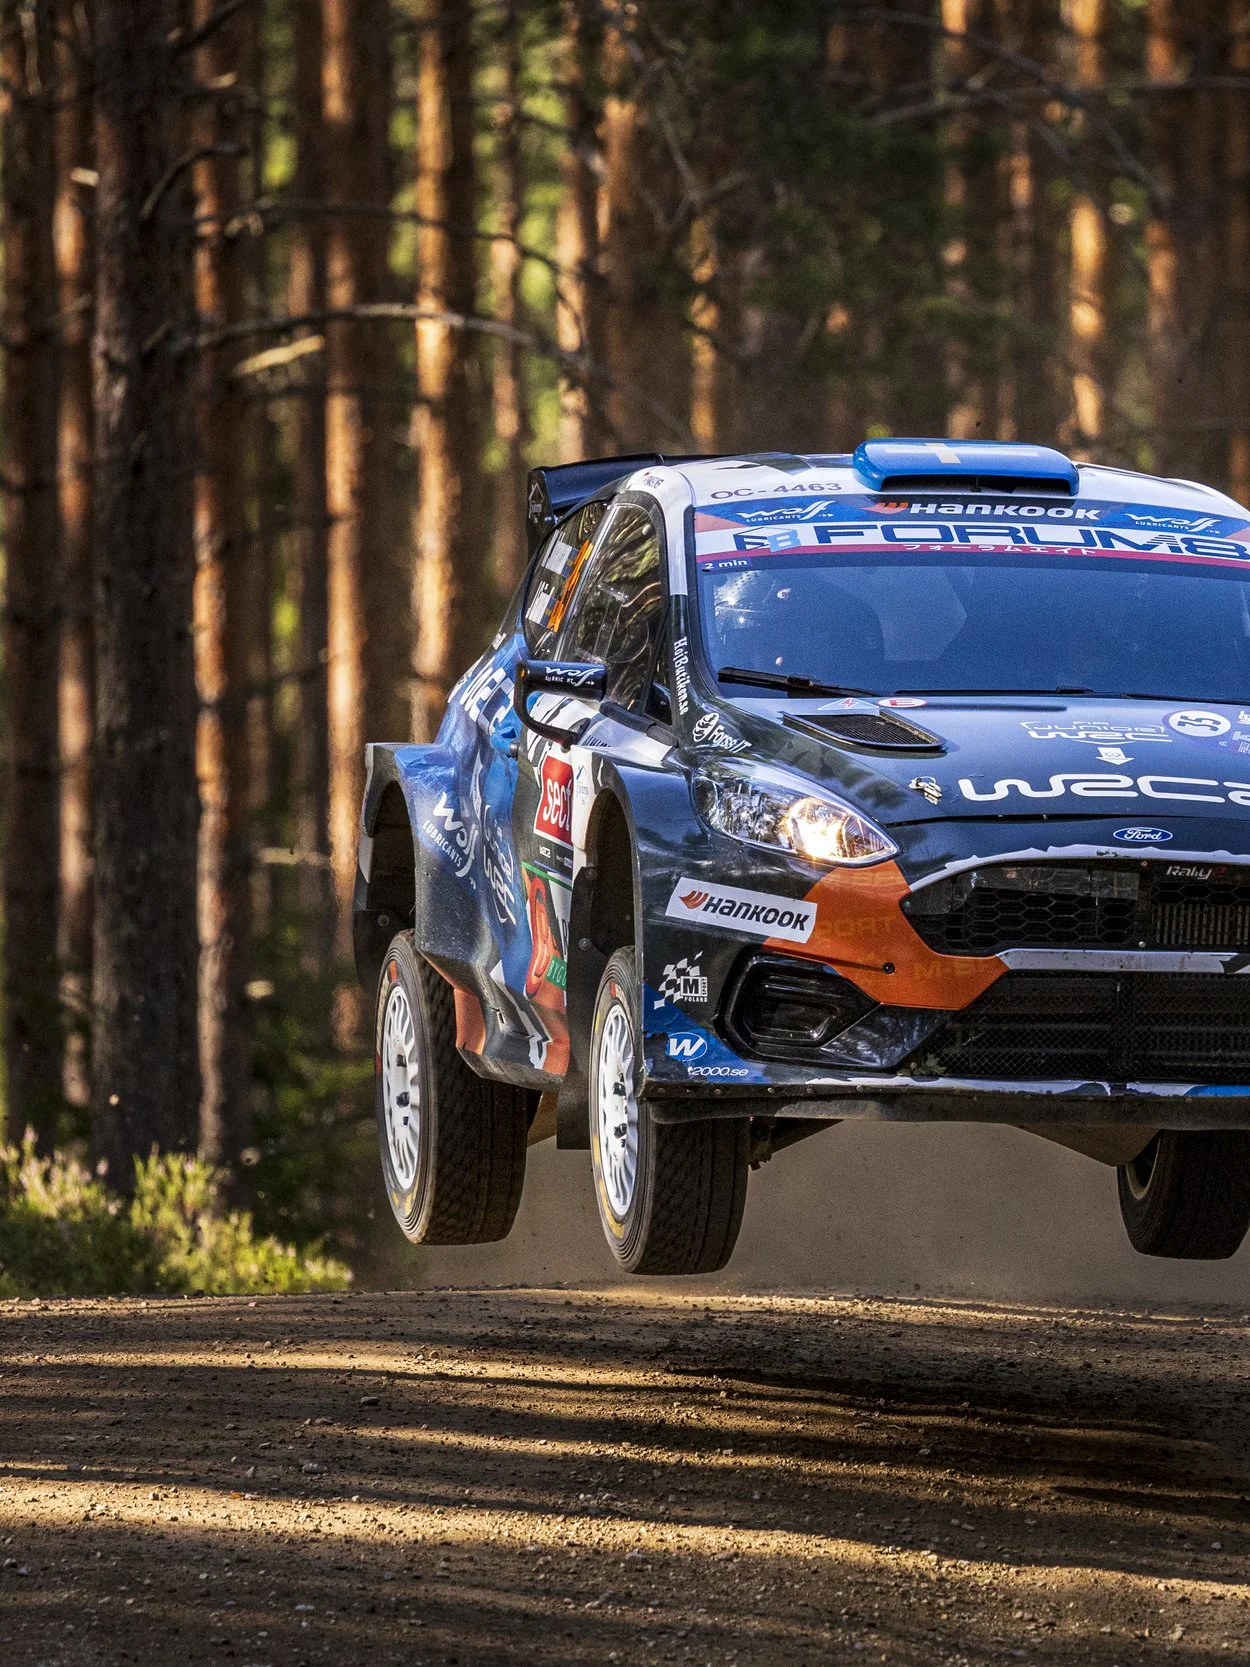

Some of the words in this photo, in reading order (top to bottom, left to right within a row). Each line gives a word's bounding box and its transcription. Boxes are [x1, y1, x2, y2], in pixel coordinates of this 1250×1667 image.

[747, 515, 801, 523] LUBRICANTS
[1136, 521, 1190, 530] LUBRICANTS
[718, 559, 748, 569] min
[1028, 731, 1173, 742] WRC
[1123, 829, 1163, 841] Ford
[422, 820, 463, 867] LUBRICANTS
